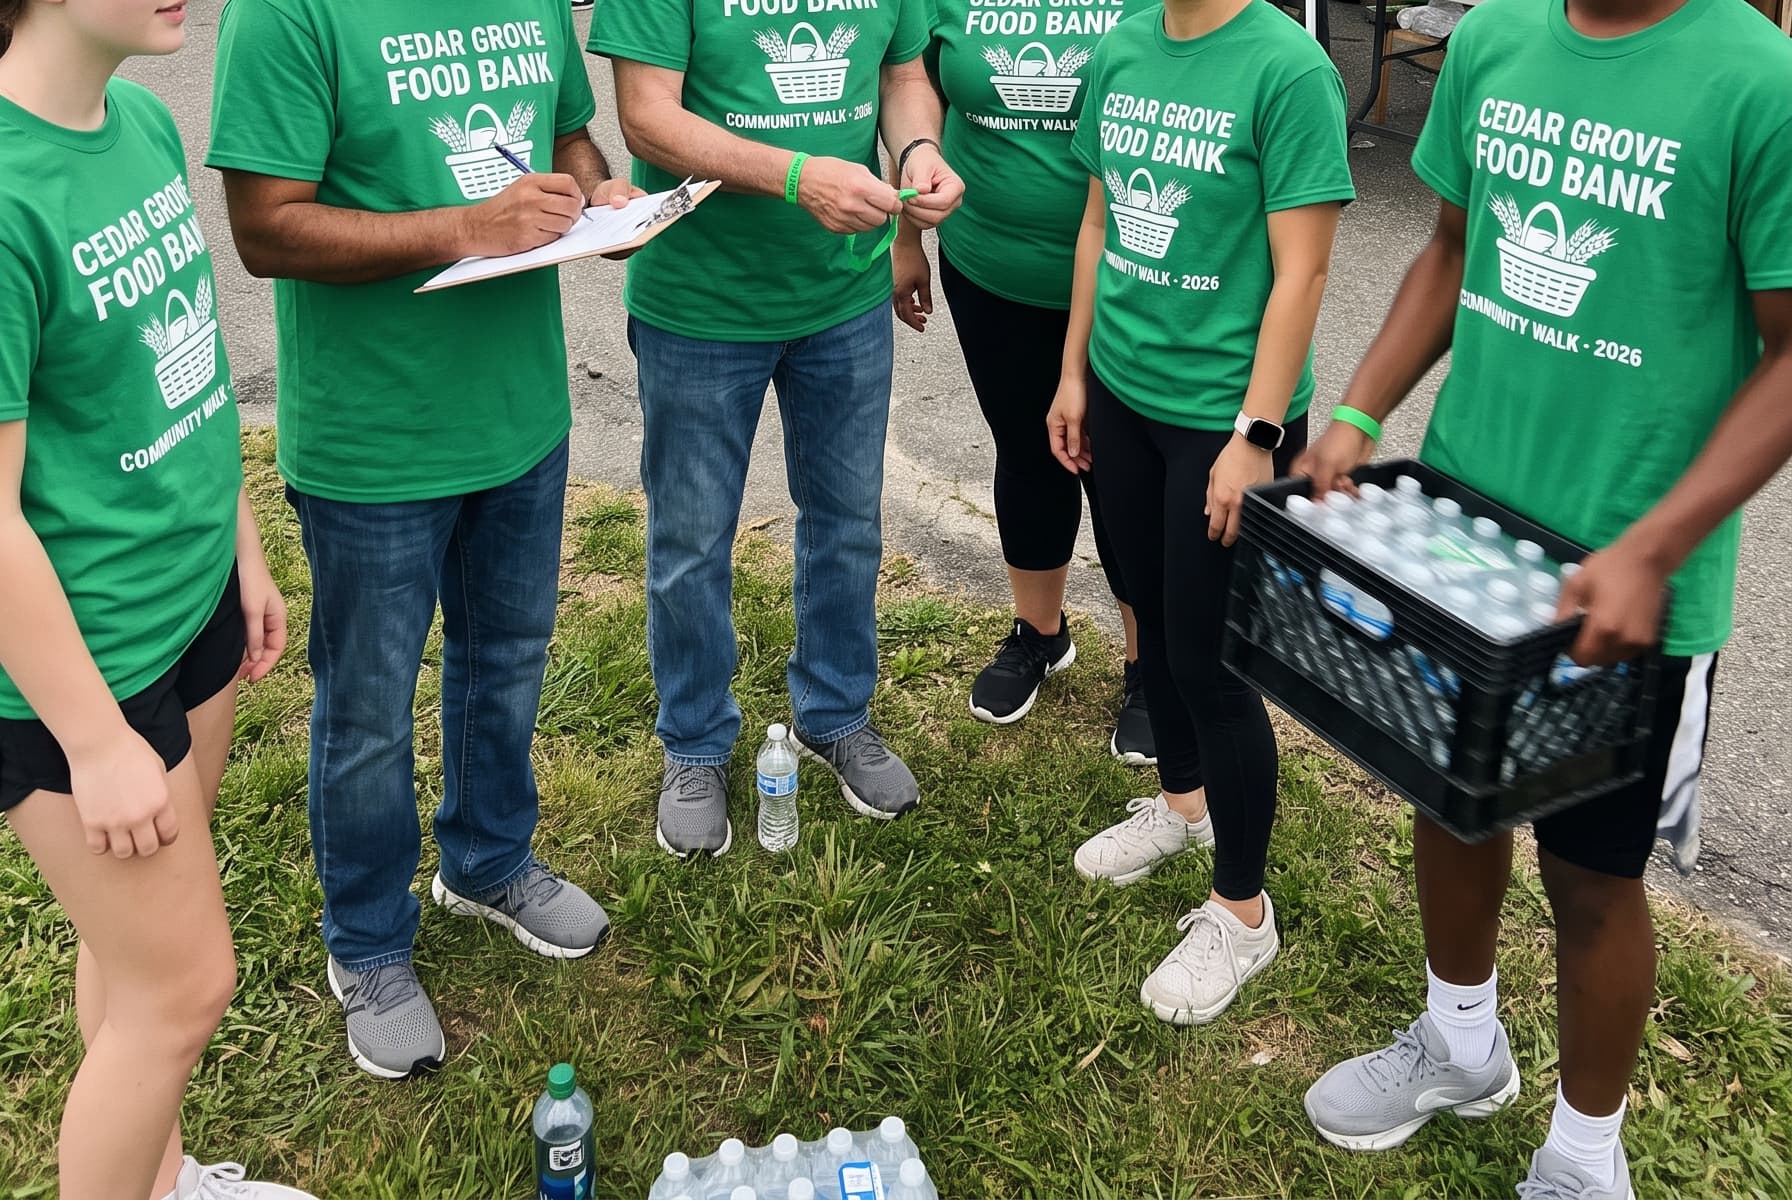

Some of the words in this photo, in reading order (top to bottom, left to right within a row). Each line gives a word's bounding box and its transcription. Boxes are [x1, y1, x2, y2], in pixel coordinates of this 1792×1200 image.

[380, 29, 467, 65] CEDAR
[471, 21, 546, 54] GROVE
[965, 10, 1037, 35] FOOD
[1045, 10, 1124, 35] BANK
[387, 62, 471, 105] FOOD
[477, 51, 555, 92] BANK
[726, 112, 810, 129] COMMUNITY
[813, 108, 847, 126] WALK
[966, 112, 1040, 130] COMMUNITY
[1041, 119, 1079, 131] WALK
[1103, 92, 1160, 125] CEDAR
[1161, 102, 1236, 139] GROVE
[1479, 97, 1565, 146] CEDAR
[1570, 118, 1682, 176] GROVE
[1100, 120, 1149, 157] FOOD
[1151, 131, 1228, 175] BANK
[1476, 132, 1554, 188] FOOD
[1561, 156, 1673, 220] BANK
[72, 209, 151, 276] CEDAR
[88, 247, 166, 322] FOOD
[1138, 264, 1171, 287] WALK
[1181, 274, 1220, 291] 2026
[1532, 320, 1580, 353] WALK
[1593, 339, 1643, 368] 2026
[120, 407, 201, 472] COMMUNITY
[201, 383, 228, 420] WALK
